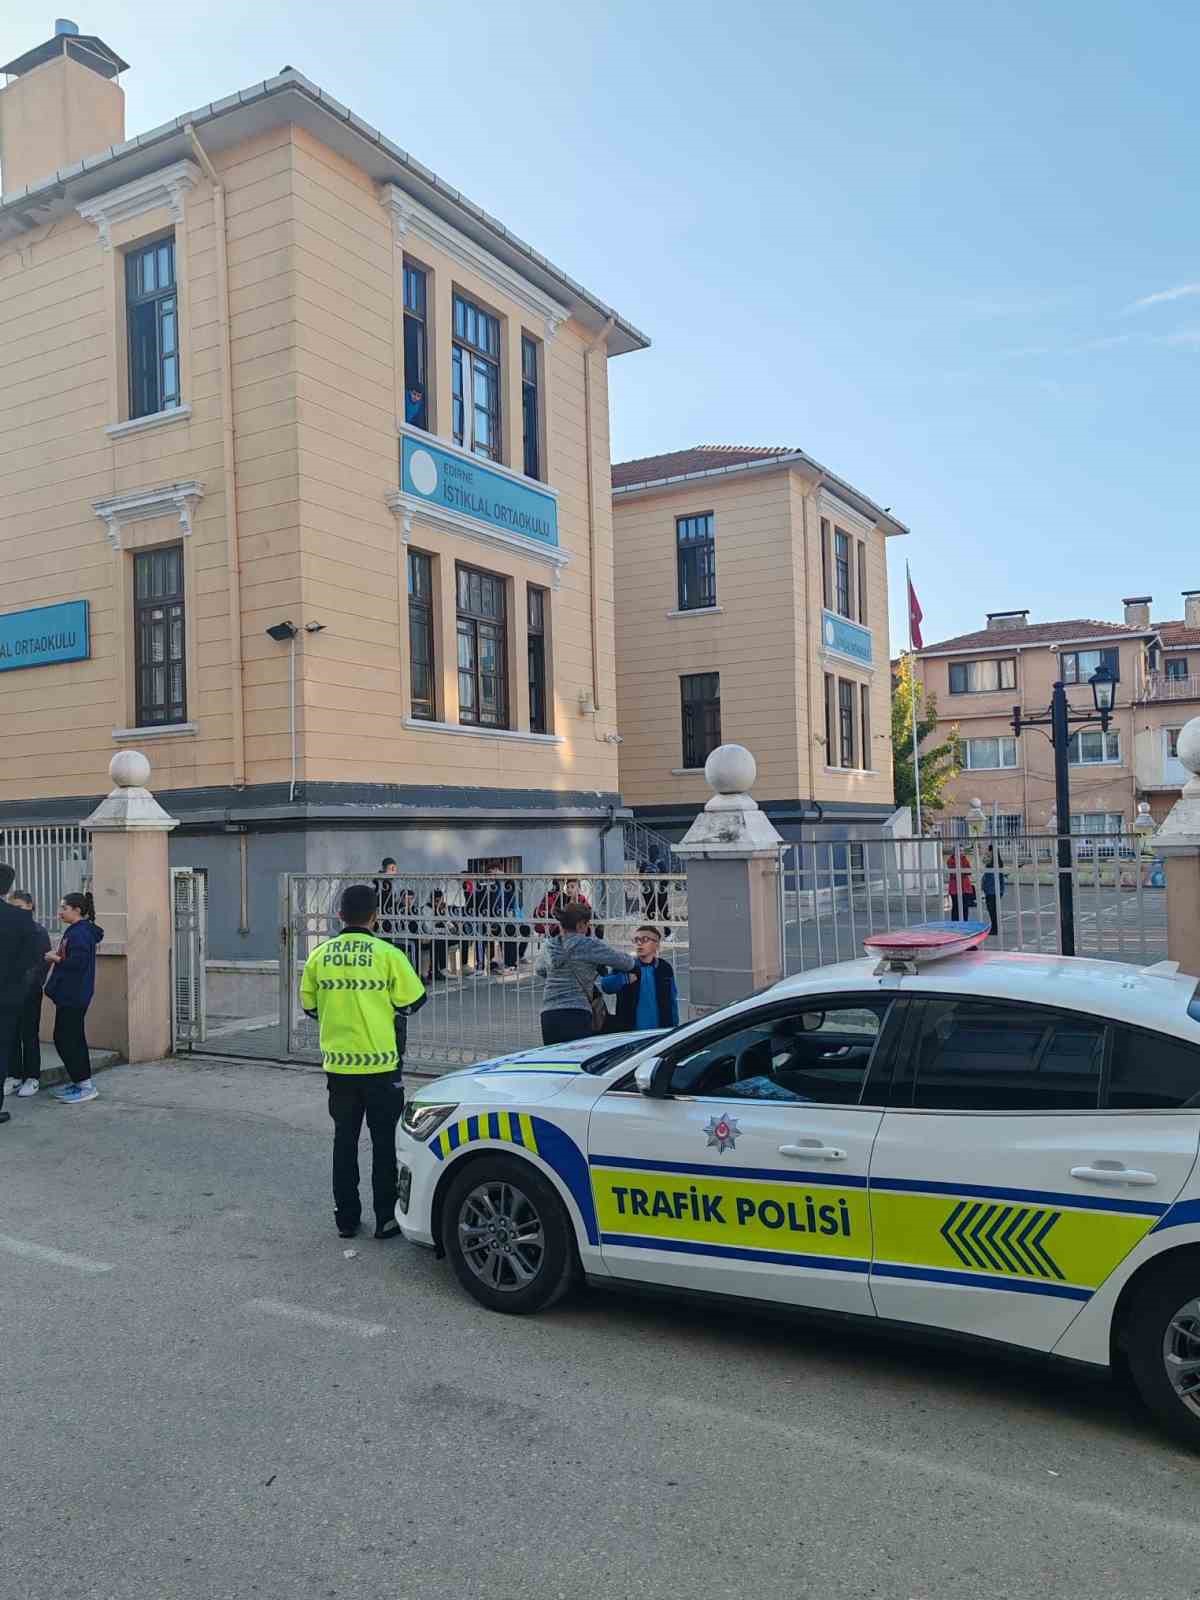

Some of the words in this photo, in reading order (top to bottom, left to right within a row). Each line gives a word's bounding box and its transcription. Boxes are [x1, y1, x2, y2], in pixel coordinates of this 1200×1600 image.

[443, 464, 473, 481] EDİRNE
[443, 479, 491, 516] İSTİKLAL
[494, 503, 550, 537] ORTAOKULU
[15, 631, 76, 656] ORTAOKULU
[326, 941, 374, 953] TRAFİK
[323, 954, 373, 967] POLİSİ
[611, 1185, 726, 1224] TRAFİK
[736, 1195, 851, 1237] POLİSİ
